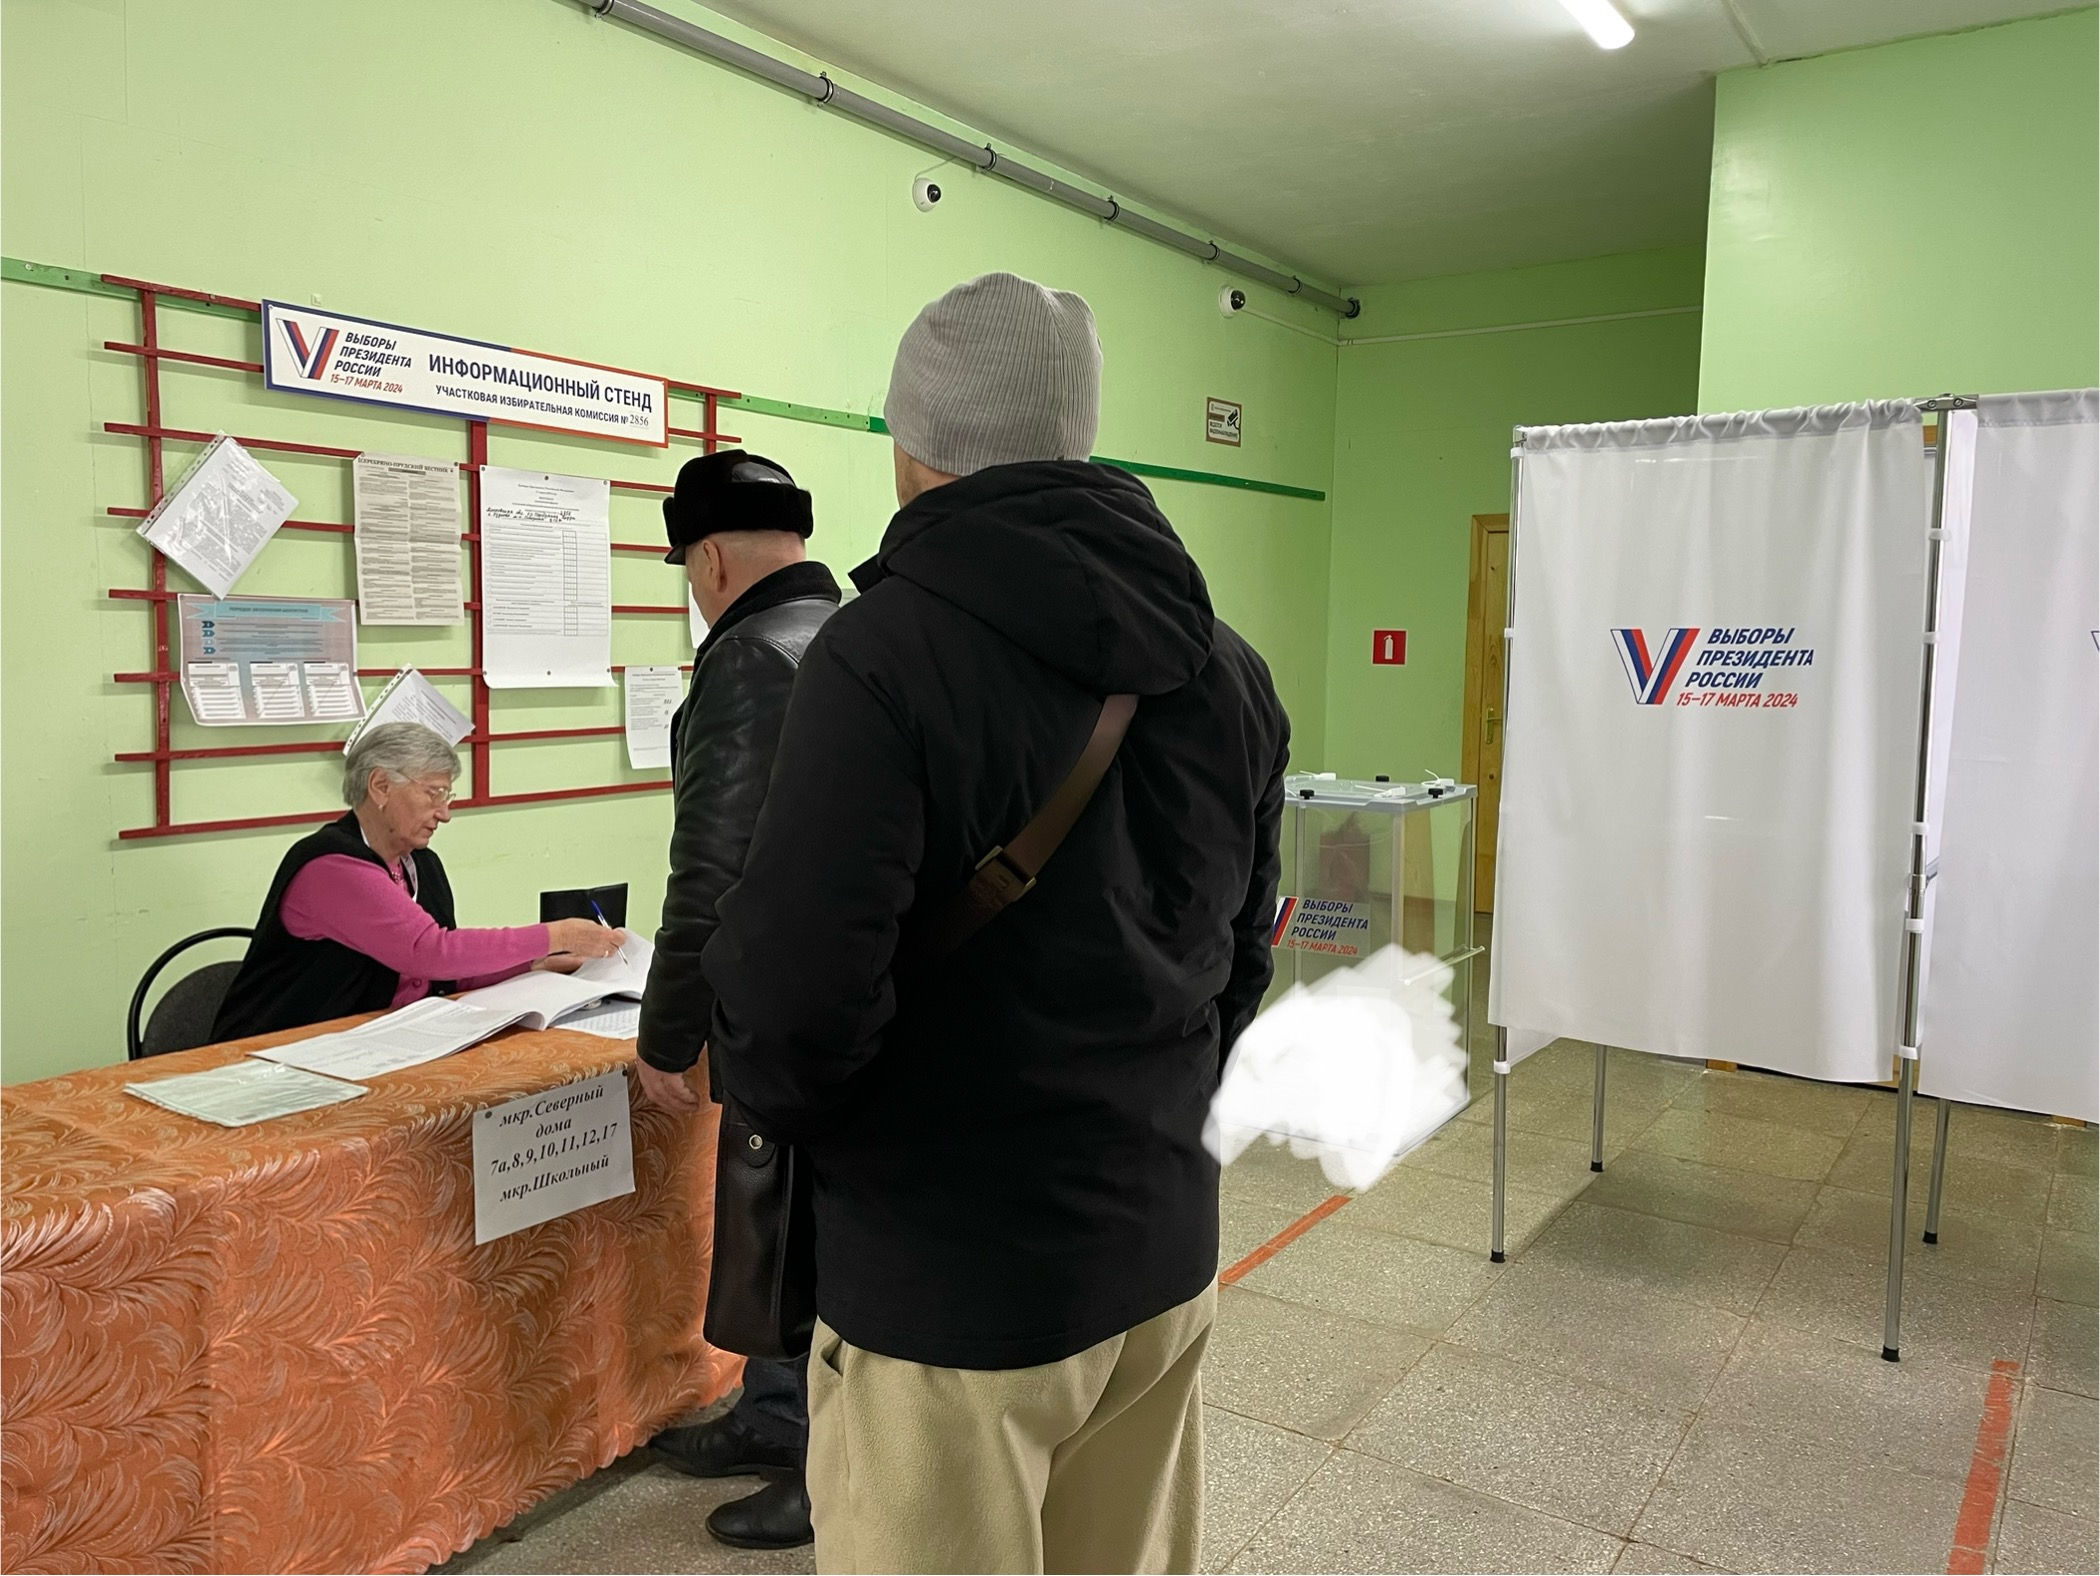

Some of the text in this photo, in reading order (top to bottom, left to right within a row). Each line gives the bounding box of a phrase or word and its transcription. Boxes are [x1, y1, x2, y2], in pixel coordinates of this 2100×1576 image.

[345, 332, 397, 351] ВЫБОРЫ
[339, 346, 412, 368] ПРЕЗИДЕНТА
[334, 360, 382, 377] РОССИИ
[354, 376, 381, 390] МАРТА
[383, 382, 403, 393] 2024
[429, 353, 652, 413] ИНФОРМАЦИОННЫЙ СТЕНД
[435, 384, 498, 404] УЧАСТКОВАЯ
[499, 395, 573, 416] ИЗБИРАТЕЛЬНАЯ
[574, 407, 619, 424] КОМИССИЯ
[629, 414, 649, 427] 2856
[1707, 627, 1796, 645] ВЫБОРЫ
[1696, 649, 1815, 669] ПРЕЗИДЕНТА
[1685, 671, 1764, 689] РОССИИ
[1715, 693, 1760, 708] МАРТА
[1762, 693, 1799, 708] 2024
[1302, 899, 1354, 914] ВЫБОРЫ
[1296, 912, 1369, 930] ПРЕЗИДЕНТА
[1291, 926, 1337, 941] РОССИИ
[1309, 941, 1337, 953] МАРТА
[1338, 944, 1358, 956] 2024
[499, 1084, 604, 1127] мкр.Северный
[535, 1117, 572, 1139] дома
[490, 1122, 618, 1176] 7а,8,9,10,11,12,17
[499, 1154, 609, 1202] мкр.Школьный
